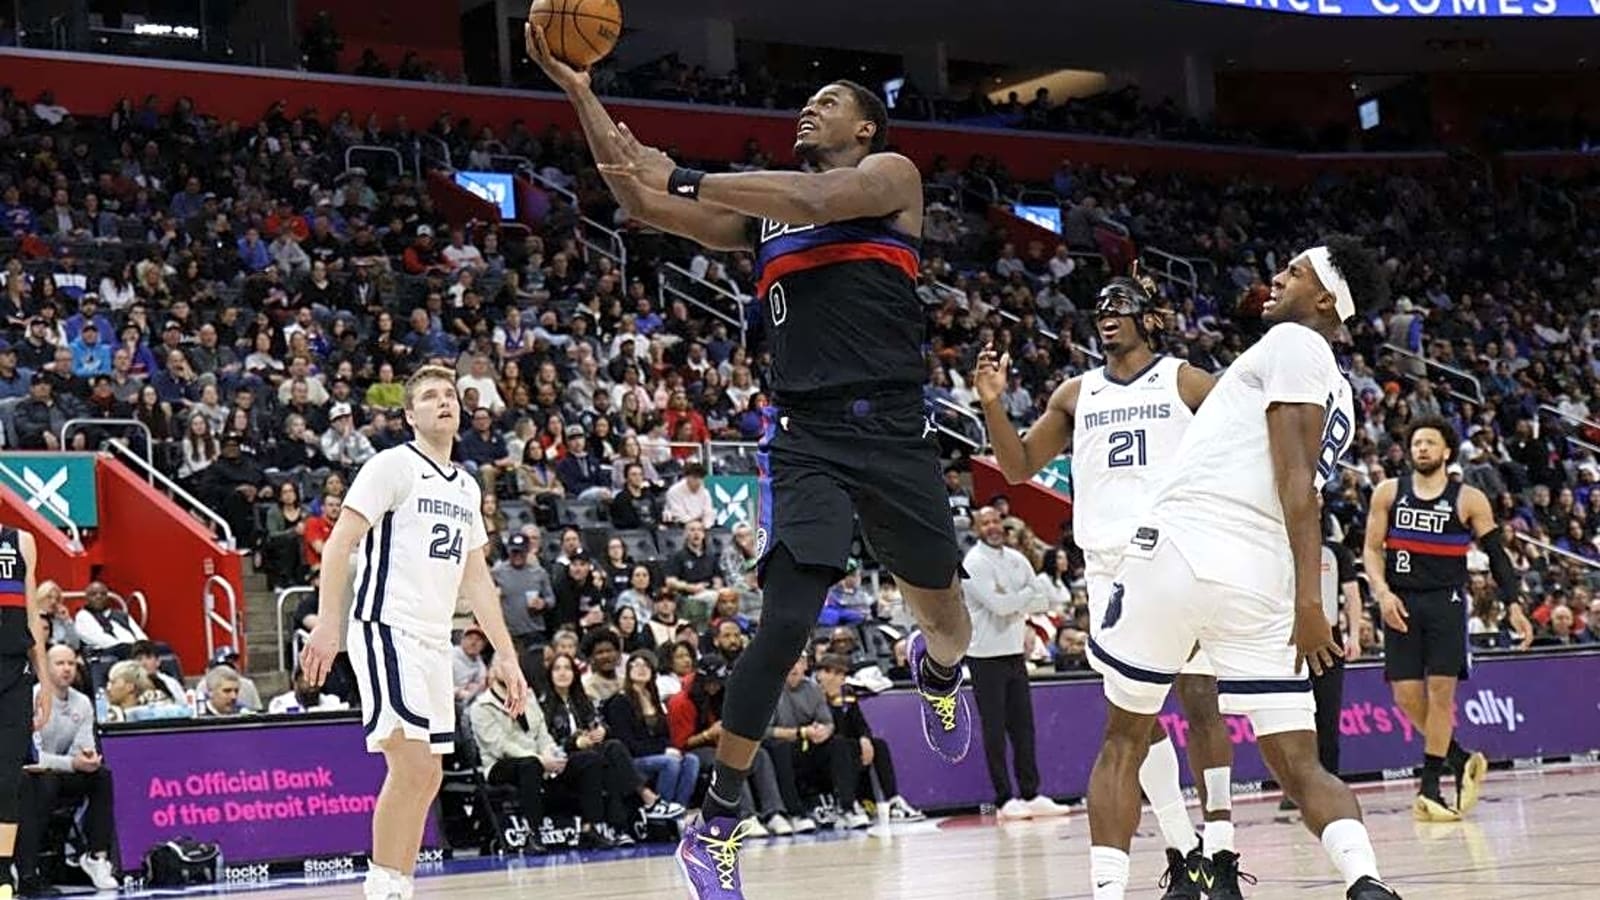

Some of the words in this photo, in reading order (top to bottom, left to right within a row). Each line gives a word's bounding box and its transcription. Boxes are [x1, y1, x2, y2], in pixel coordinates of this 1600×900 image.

[769, 282, 787, 326] 0
[1084, 403, 1171, 430] MEMPHIS
[1108, 429, 1147, 467] 21
[1395, 507, 1450, 534] DET
[429, 523, 462, 565] 24
[1395, 550, 1411, 573] 2
[1465, 690, 1525, 731] ally.
[149, 777, 182, 798] An
[186, 770, 270, 796] Official
[272, 766, 333, 790] Bank
[153, 804, 176, 827] of
[181, 803, 221, 825] the
[224, 795, 305, 822] Detroit
[307, 793, 376, 816] Piston
[225, 863, 270, 879] tockX
[304, 857, 354, 873] StockX
